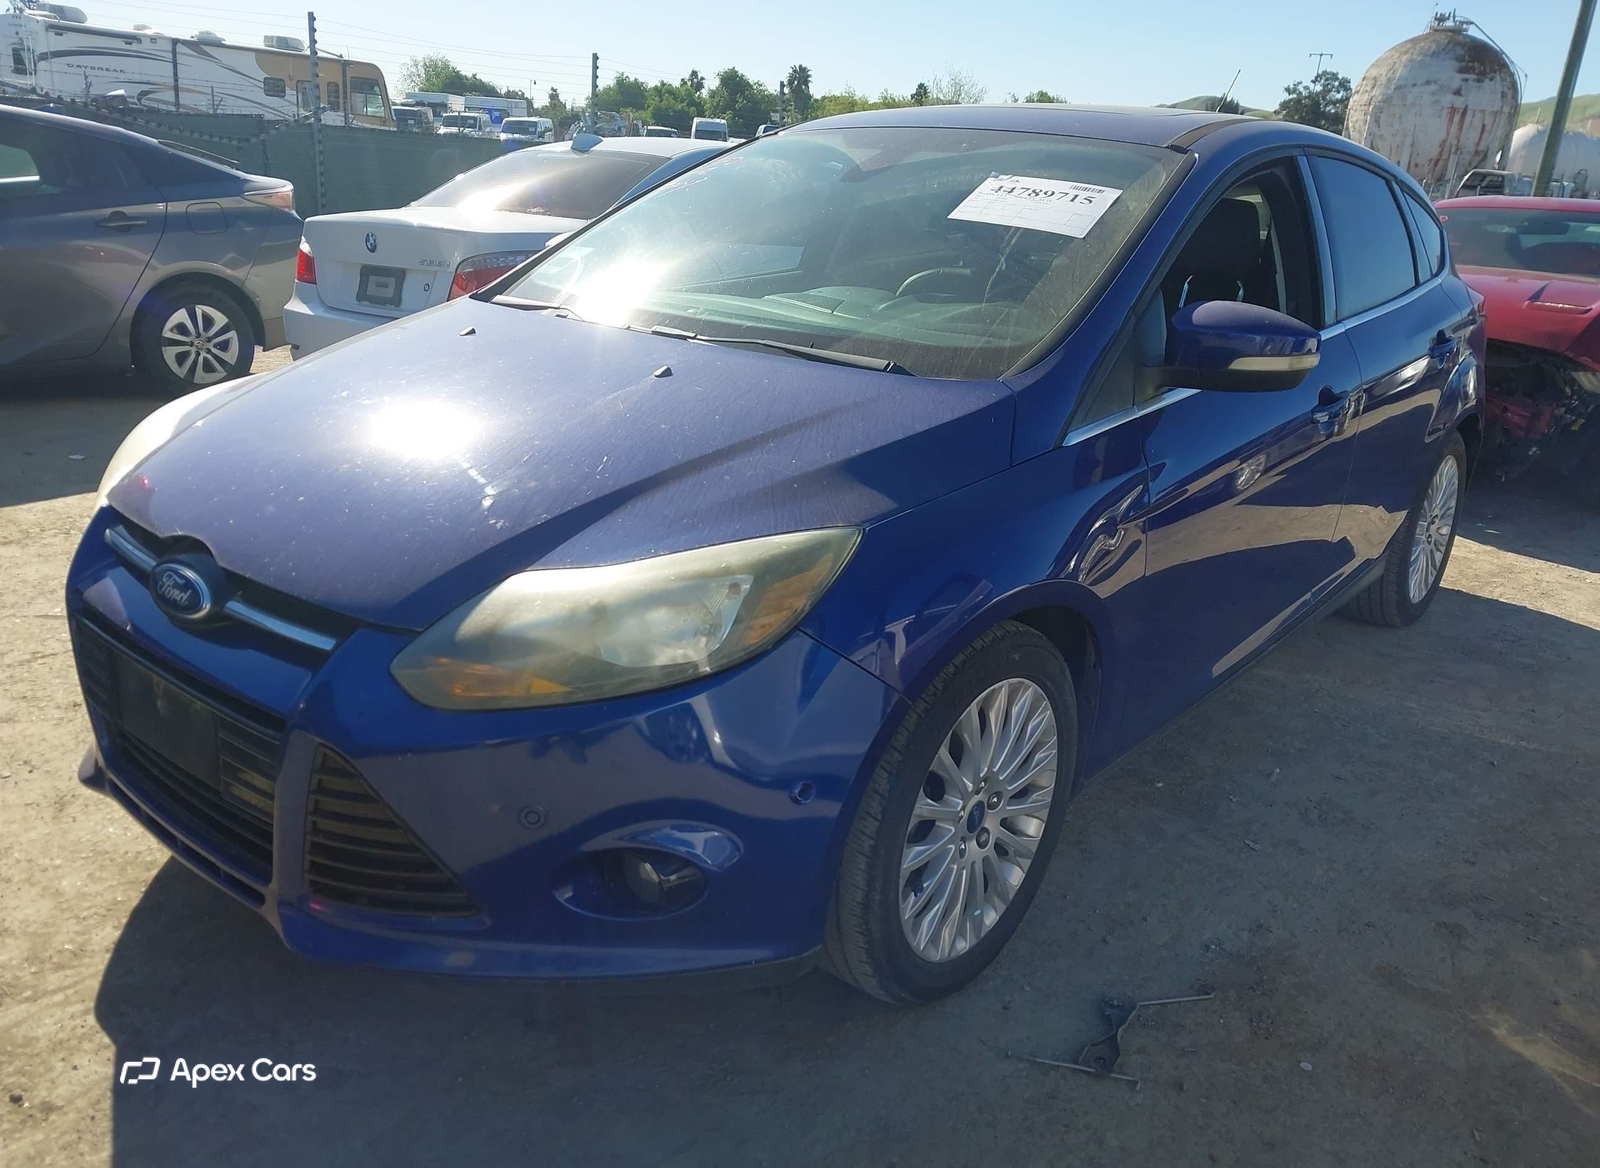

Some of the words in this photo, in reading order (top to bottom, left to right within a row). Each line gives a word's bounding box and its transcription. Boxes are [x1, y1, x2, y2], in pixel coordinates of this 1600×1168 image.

[66, 63, 126, 74] DAYBREAK
[990, 184, 1097, 205] 44789715
[157, 571, 192, 606] Ford
